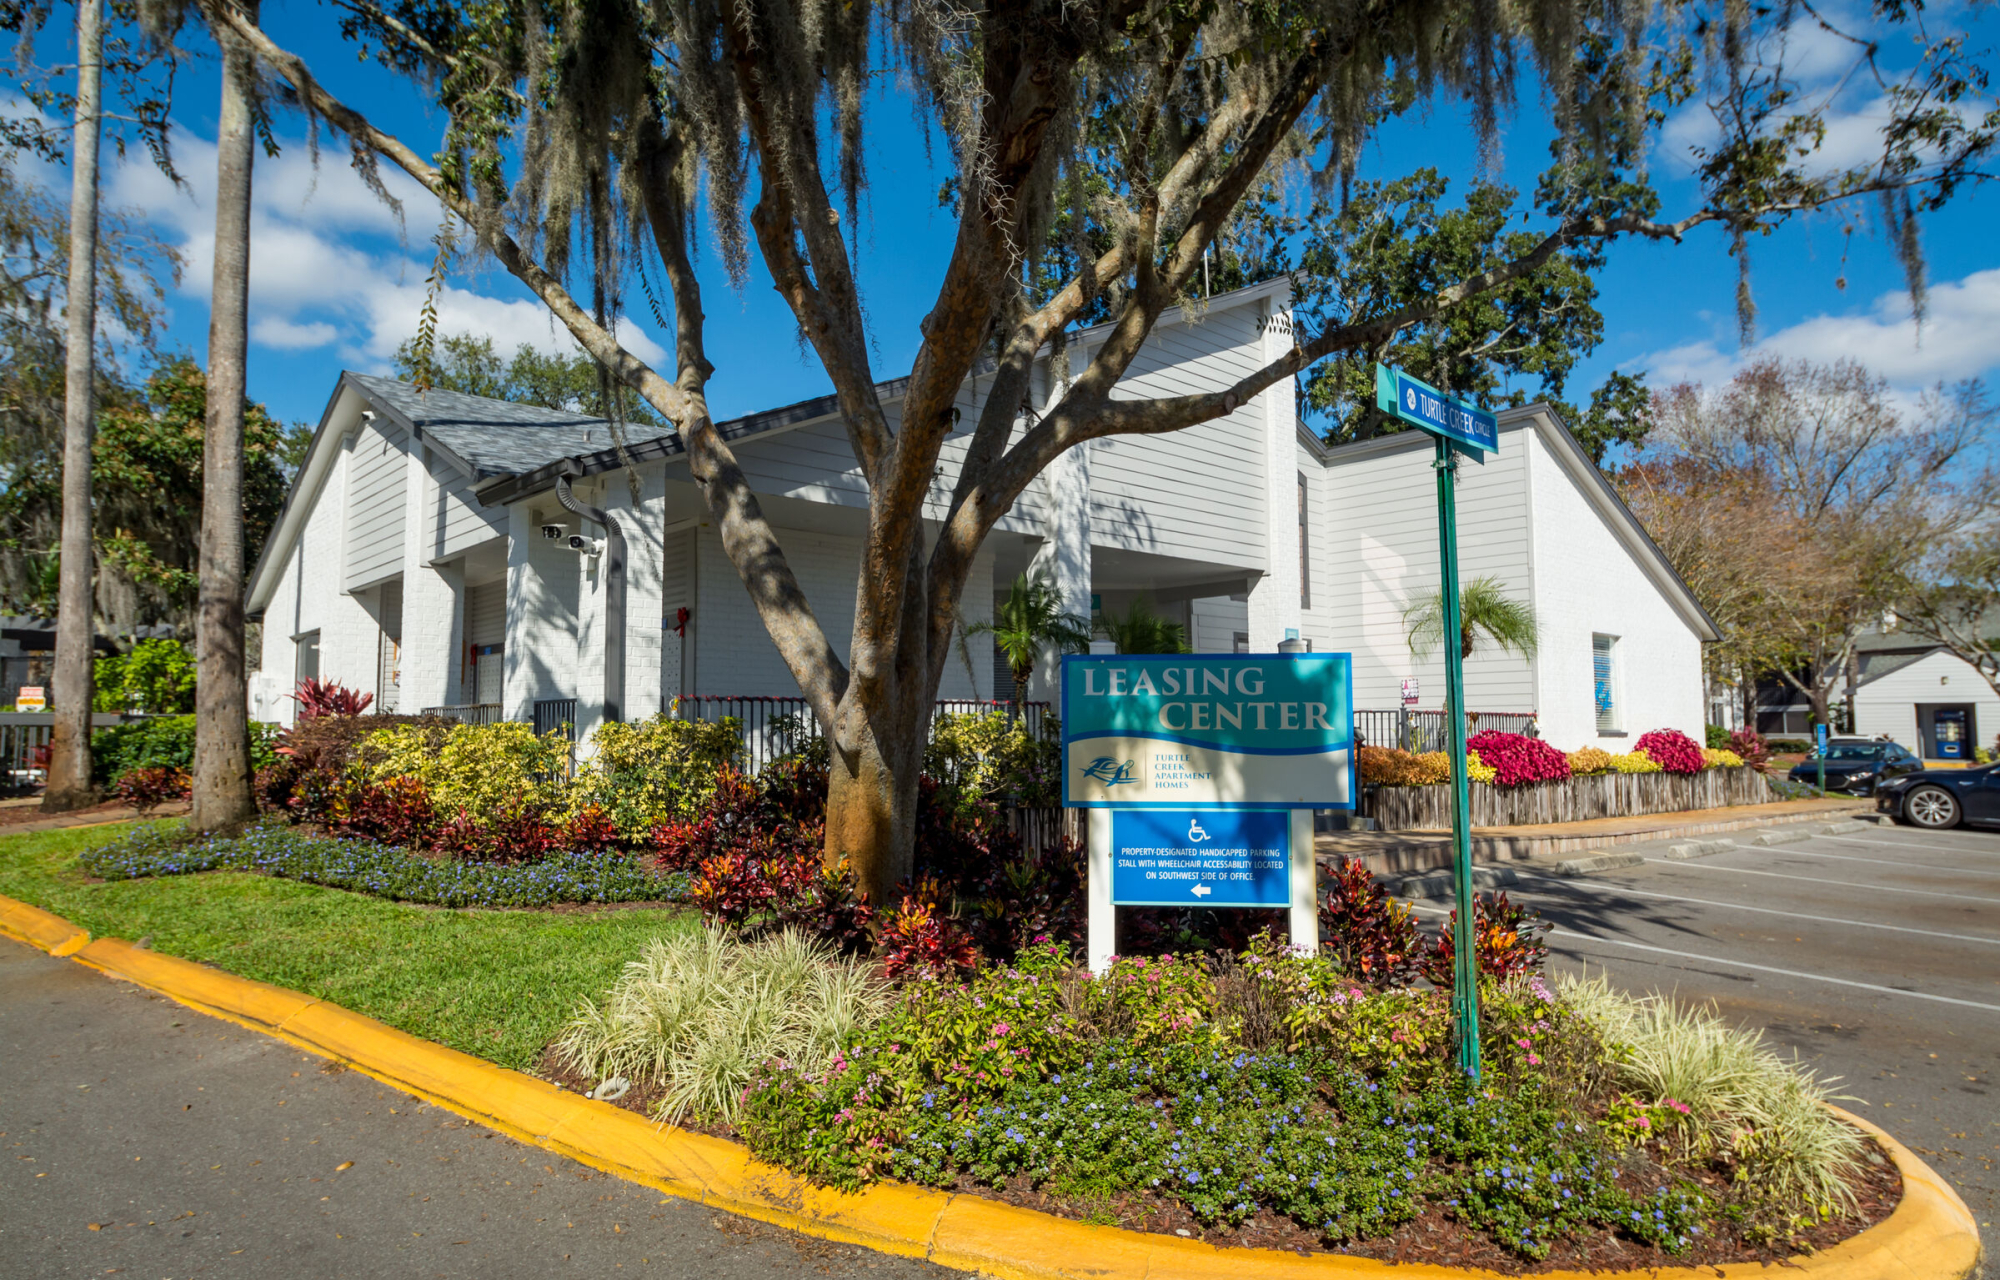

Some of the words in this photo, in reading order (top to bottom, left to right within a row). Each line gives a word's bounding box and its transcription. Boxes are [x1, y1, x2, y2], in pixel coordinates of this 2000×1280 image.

[1420, 394, 1447, 425] TURTLE
[1449, 408, 1474, 435] CREEK
[1083, 667, 1266, 696] LEASING
[1158, 701, 1335, 731] CENTER
[1154, 772, 1211, 780] APARTMENT
[1121, 847, 1198, 857] PROPERTY-DESIGNATED
[1199, 848, 1248, 857] HANDICAPPED
[1250, 848, 1280, 858] PARKING
[1118, 859, 1137, 868] STALL
[1138, 859, 1156, 868] WITH
[1158, 859, 1201, 868] WHEELCHAIR
[1203, 860, 1252, 869] ACCESSABILITY
[1254, 860, 1284, 869] LOCATED
[1145, 871, 1157, 880] ON
[1158, 871, 1199, 880] SOUTHWEST
[1201, 871, 1217, 880] SIDE
[1218, 872, 1228, 881] OF
[1229, 872, 1256, 881] OFFICE.
